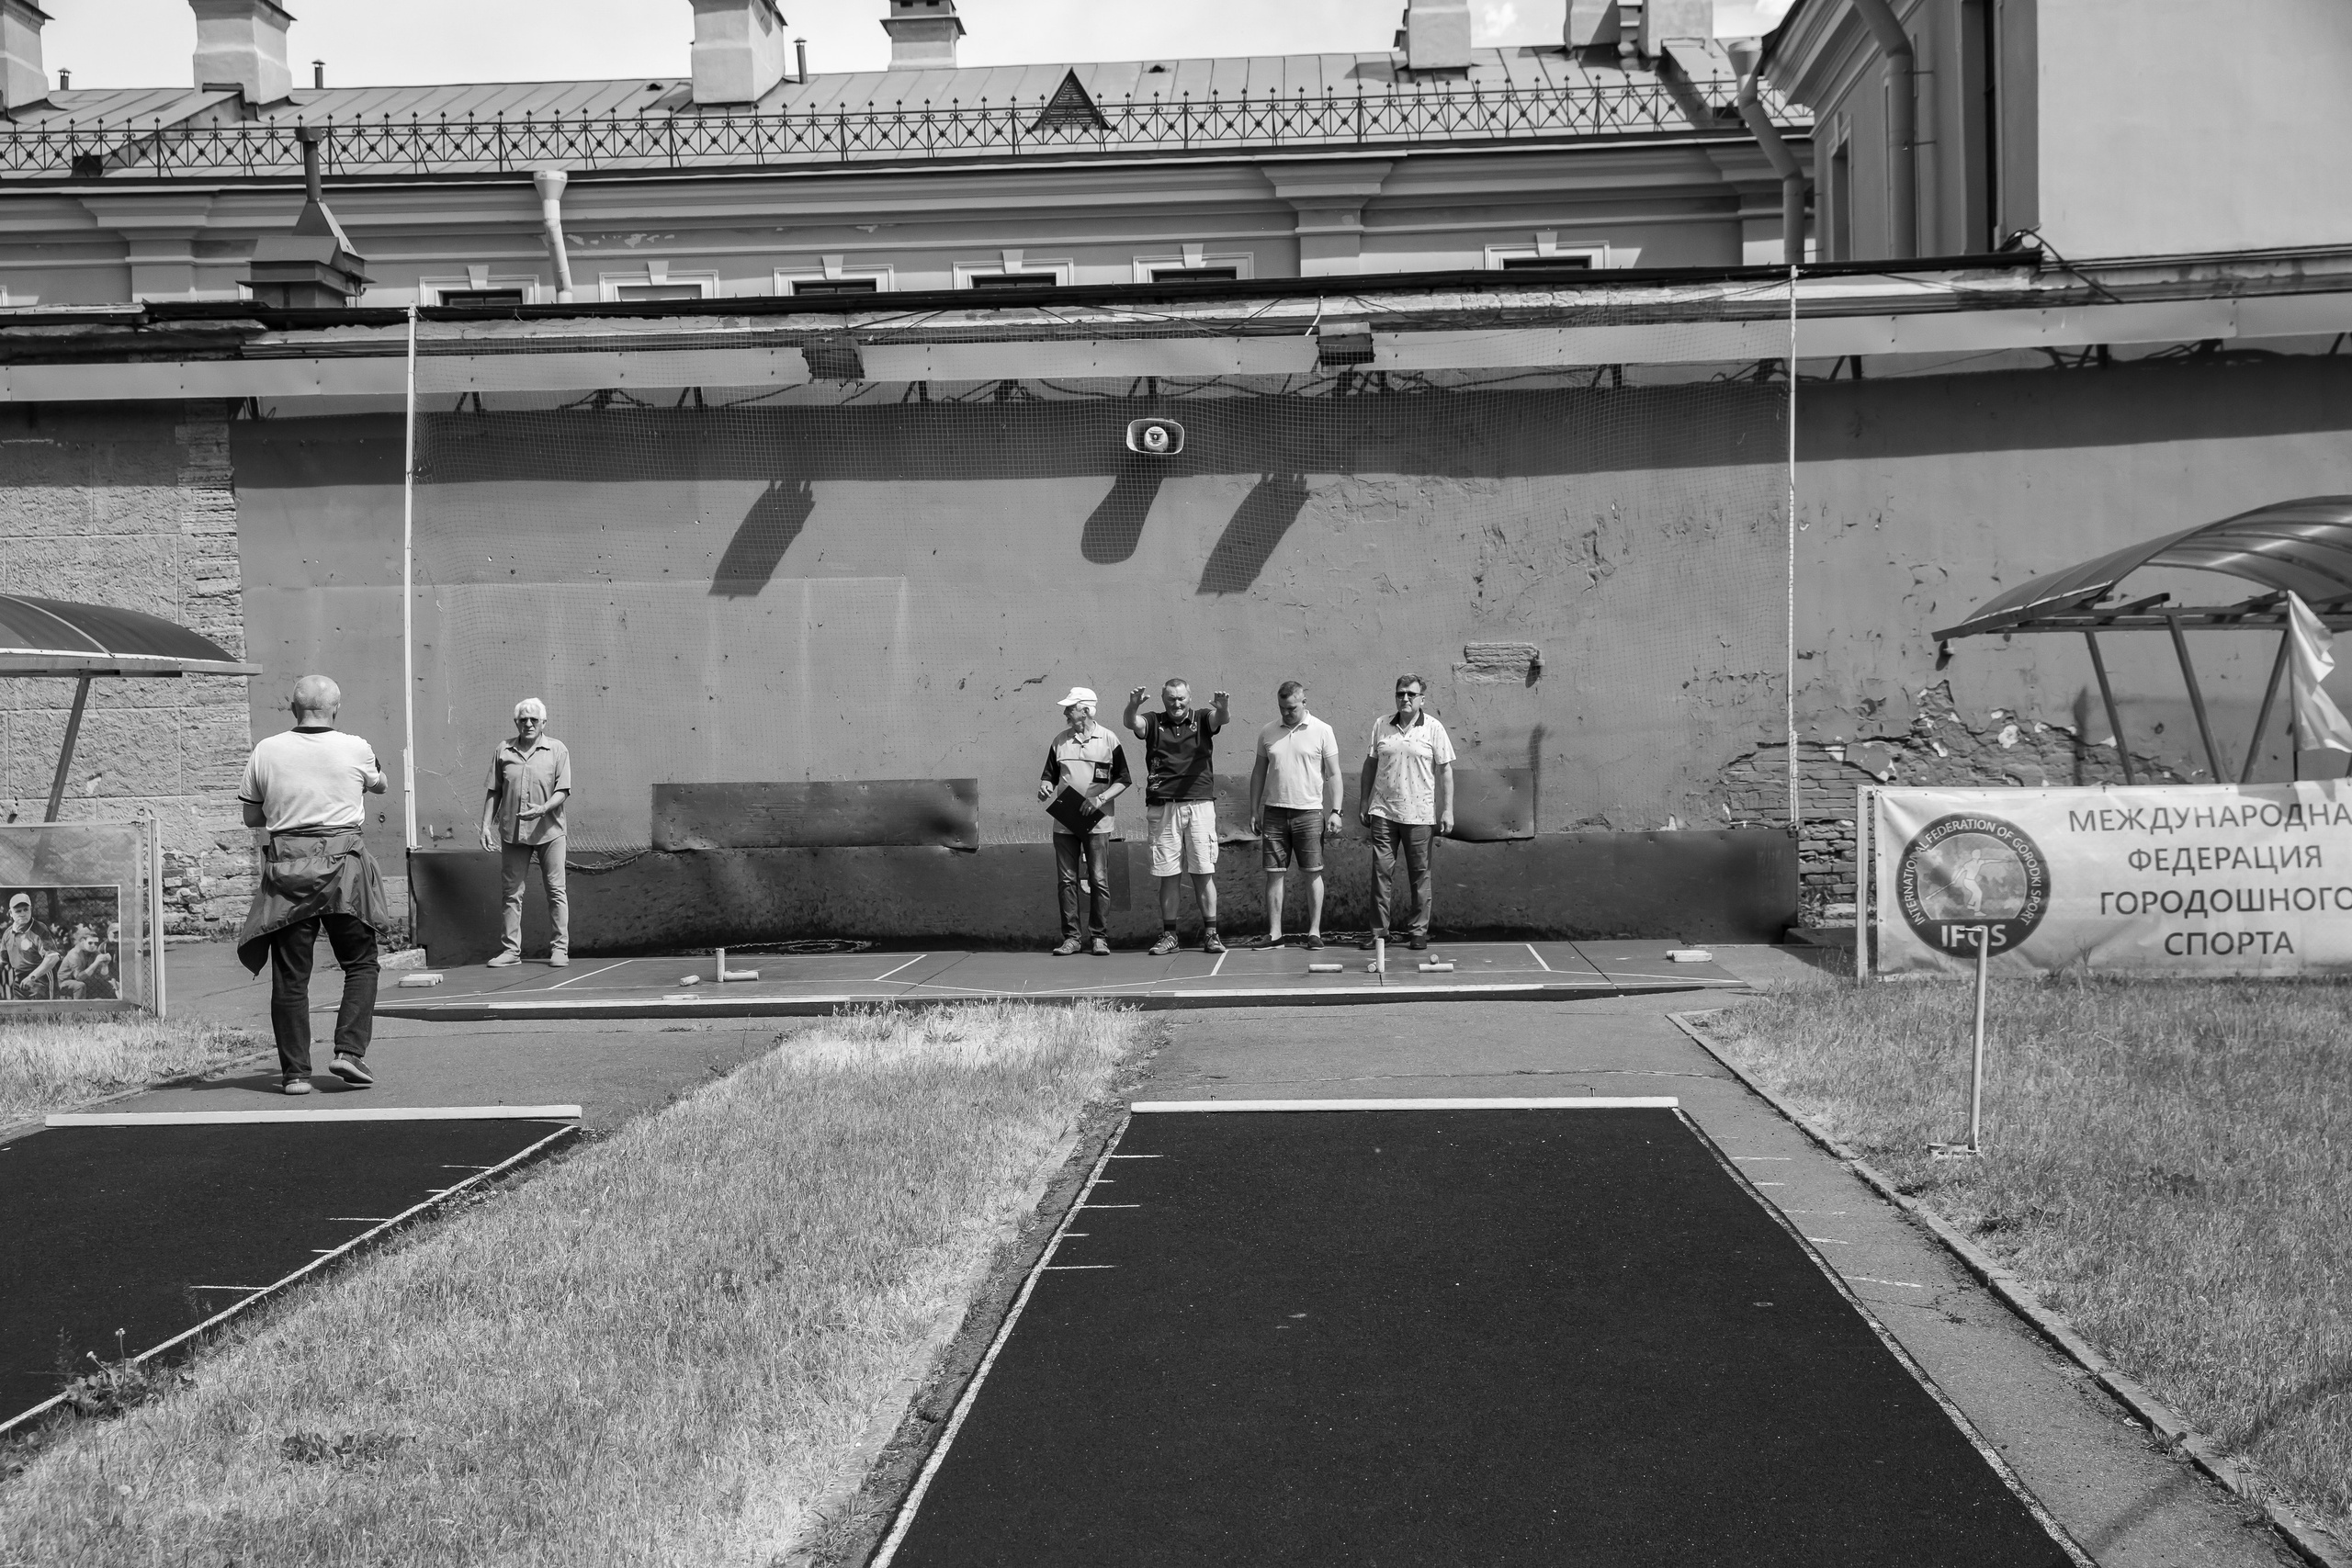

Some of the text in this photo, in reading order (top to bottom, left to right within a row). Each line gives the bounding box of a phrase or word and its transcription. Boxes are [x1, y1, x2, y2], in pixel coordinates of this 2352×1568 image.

[1925, 818, 1996, 844] FEDERATION
[1996, 826, 2014, 840] OF
[2069, 803, 2352, 835] МЕЖДУНАРОДНА
[2012, 838, 2041, 886] GORODKI
[2128, 845, 2323, 876] ФЕДЕРАЦИЯ
[2020, 889, 2041, 926] SPORT
[2100, 886, 2352, 919] ГОРОДОШНОГО
[2164, 931, 2294, 955] СПОРТА
